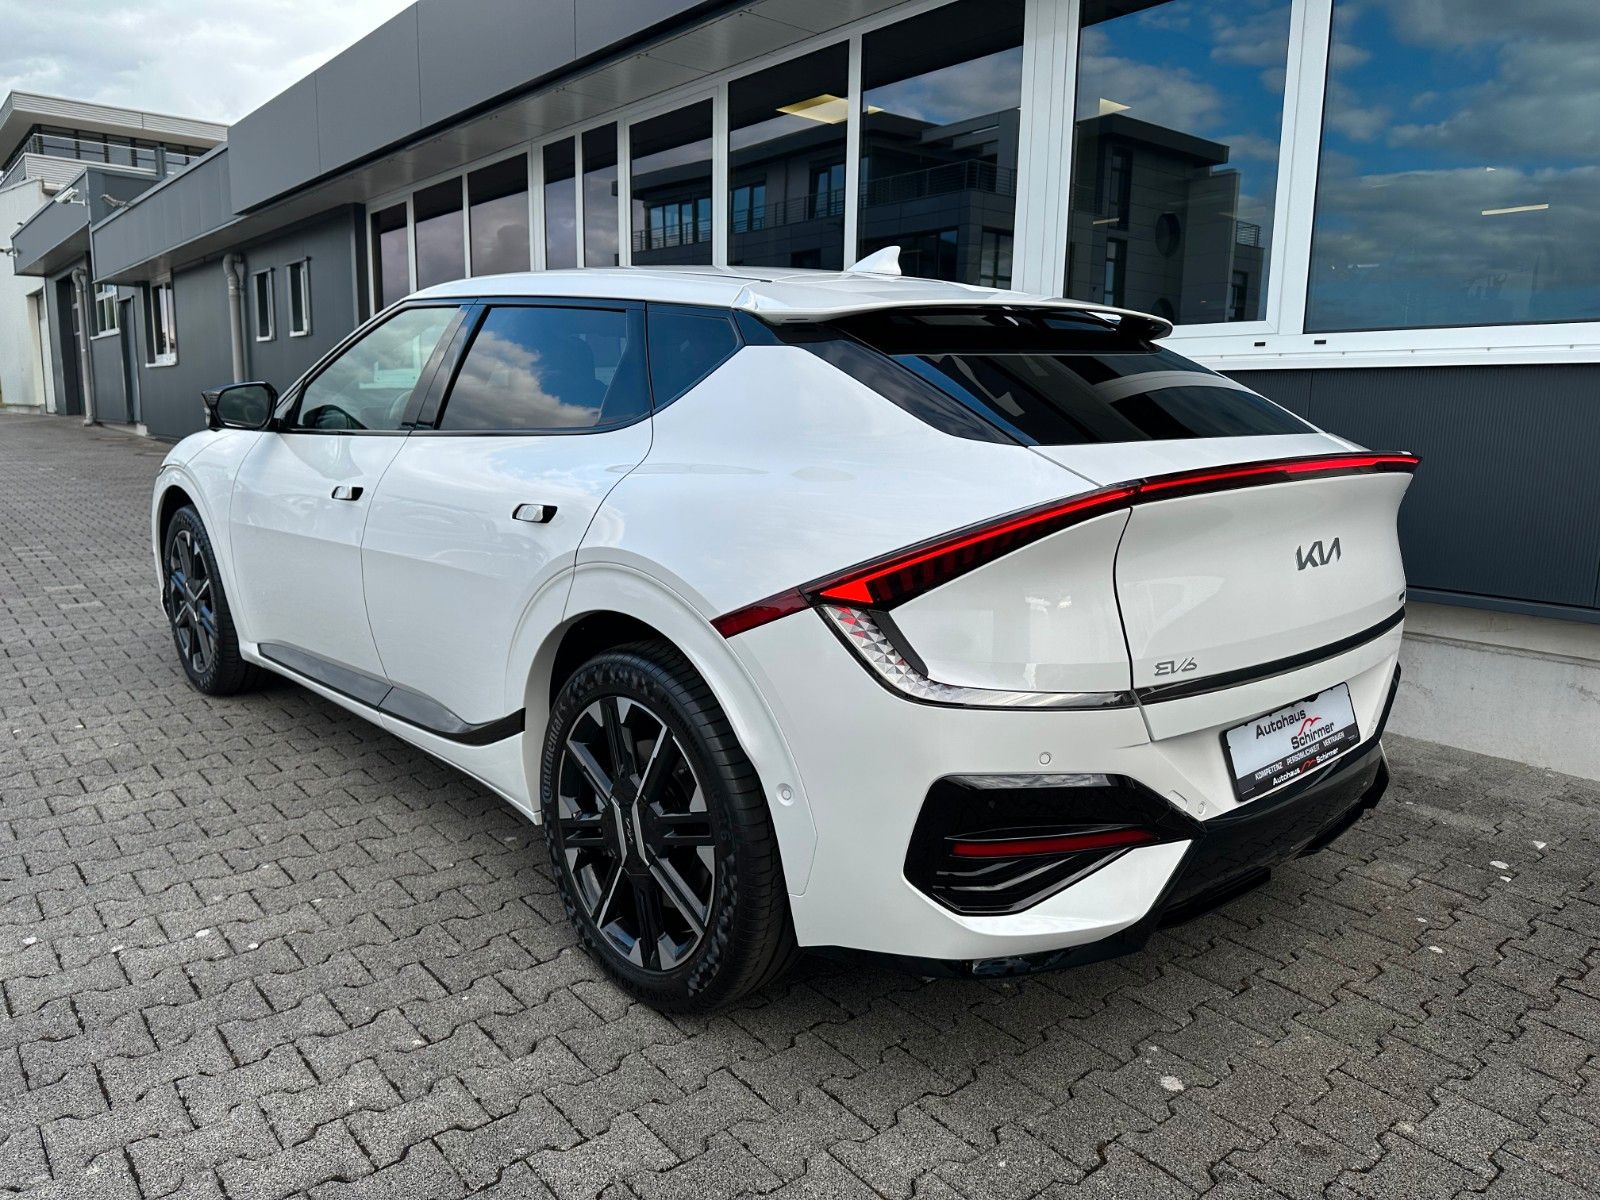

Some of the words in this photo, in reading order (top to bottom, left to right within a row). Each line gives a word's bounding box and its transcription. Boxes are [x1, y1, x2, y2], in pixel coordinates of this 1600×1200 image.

[1296, 537, 1341, 571] KIA
[1154, 656, 1198, 677] EV6
[1256, 710, 1306, 739] Autohaus
[1291, 722, 1334, 749] Schirmer
[1255, 761, 1283, 780] KOMPETENZ
[1323, 731, 1345, 746] VERTRAUEN
[1273, 768, 1300, 785] Autohaus
[1316, 748, 1339, 763] Schirmer
